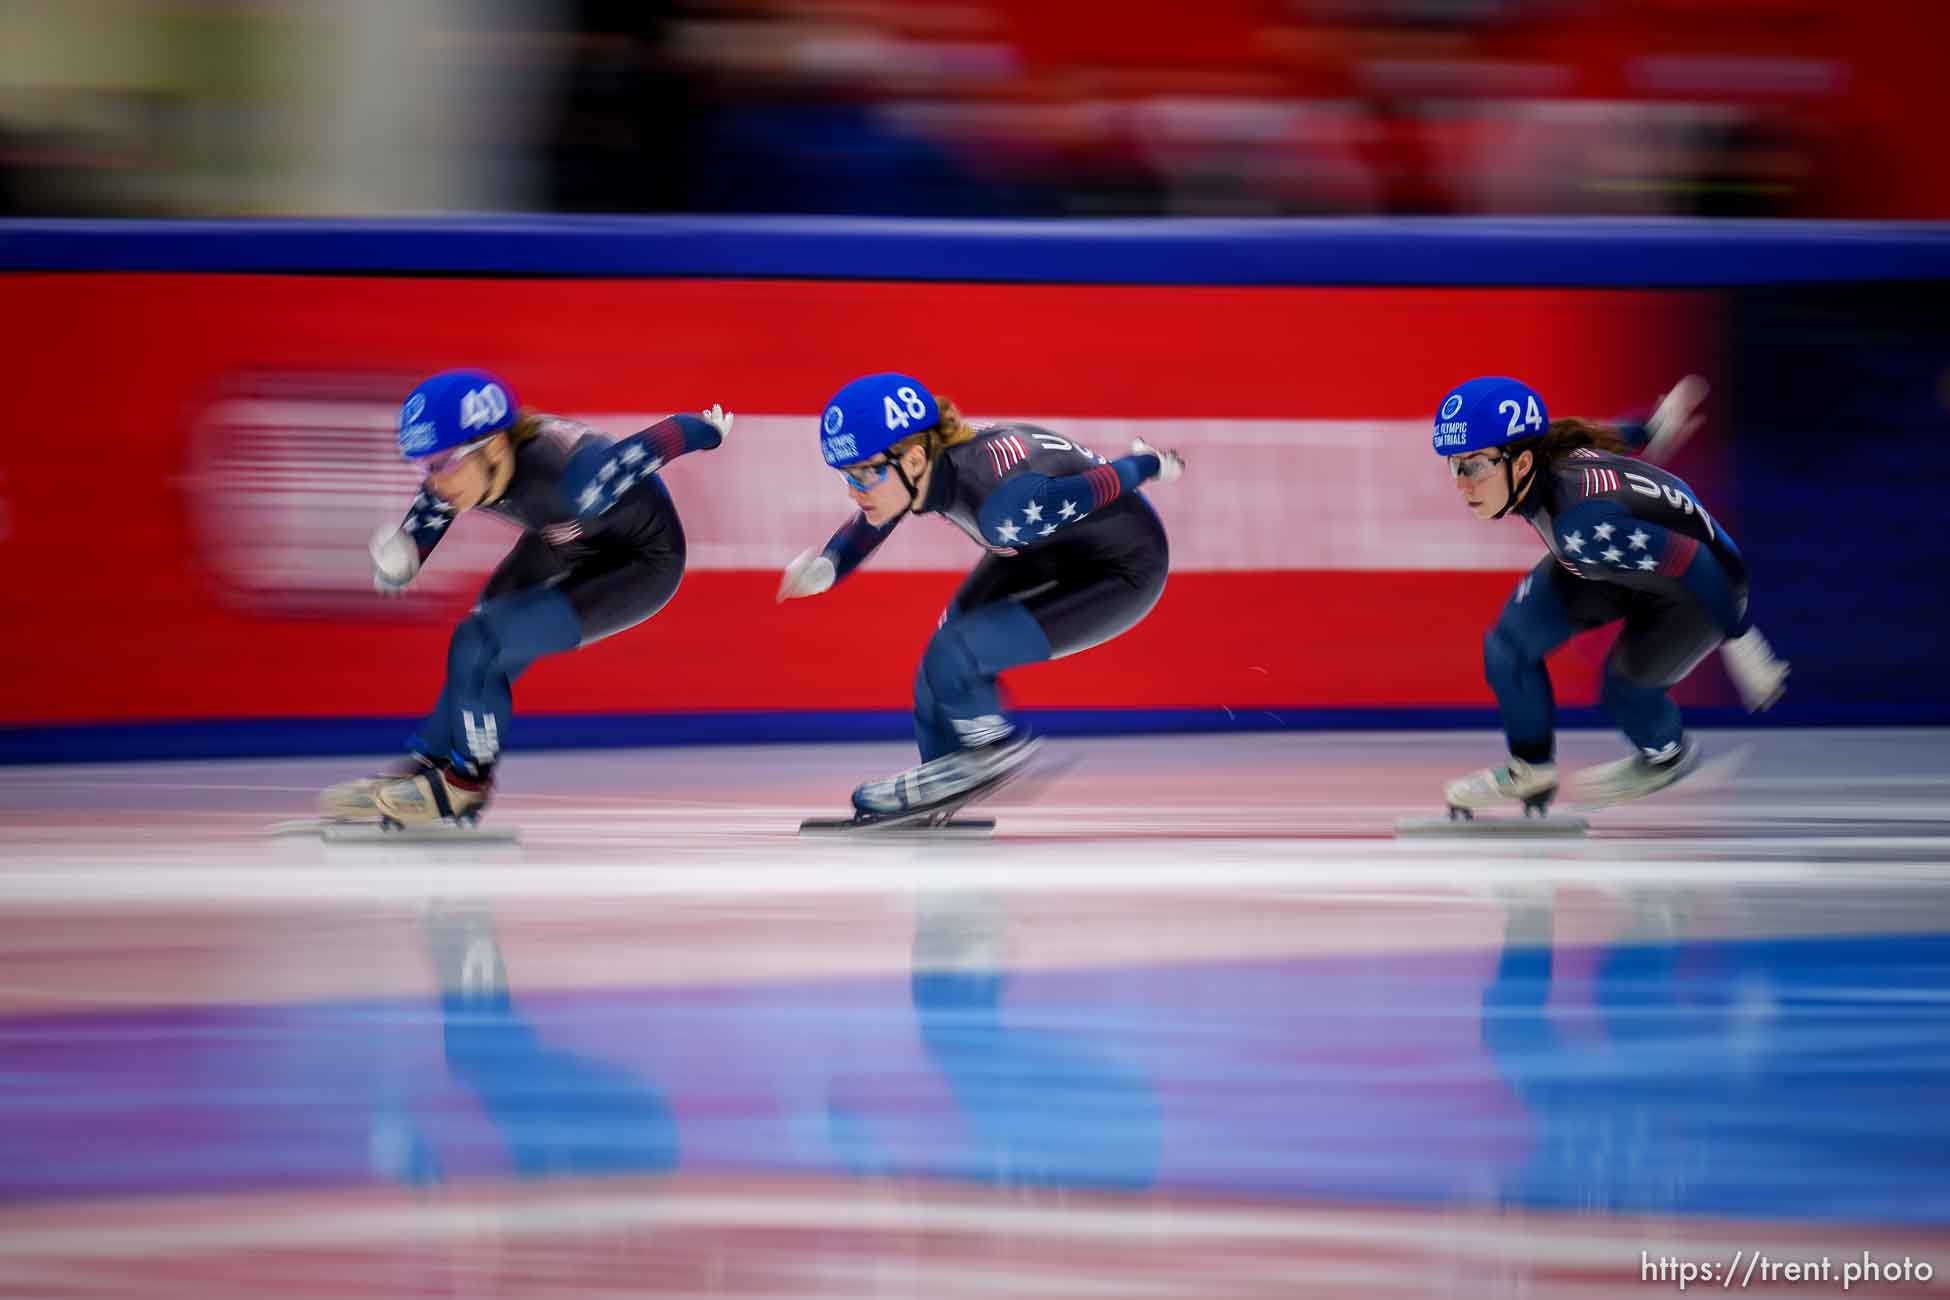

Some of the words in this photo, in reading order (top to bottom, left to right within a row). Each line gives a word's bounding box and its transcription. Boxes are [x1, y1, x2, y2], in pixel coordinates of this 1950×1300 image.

[460, 383, 508, 430] 40
[883, 386, 926, 431] 48
[1498, 395, 1542, 437] 24
[1444, 433, 1467, 446] TRIALS
